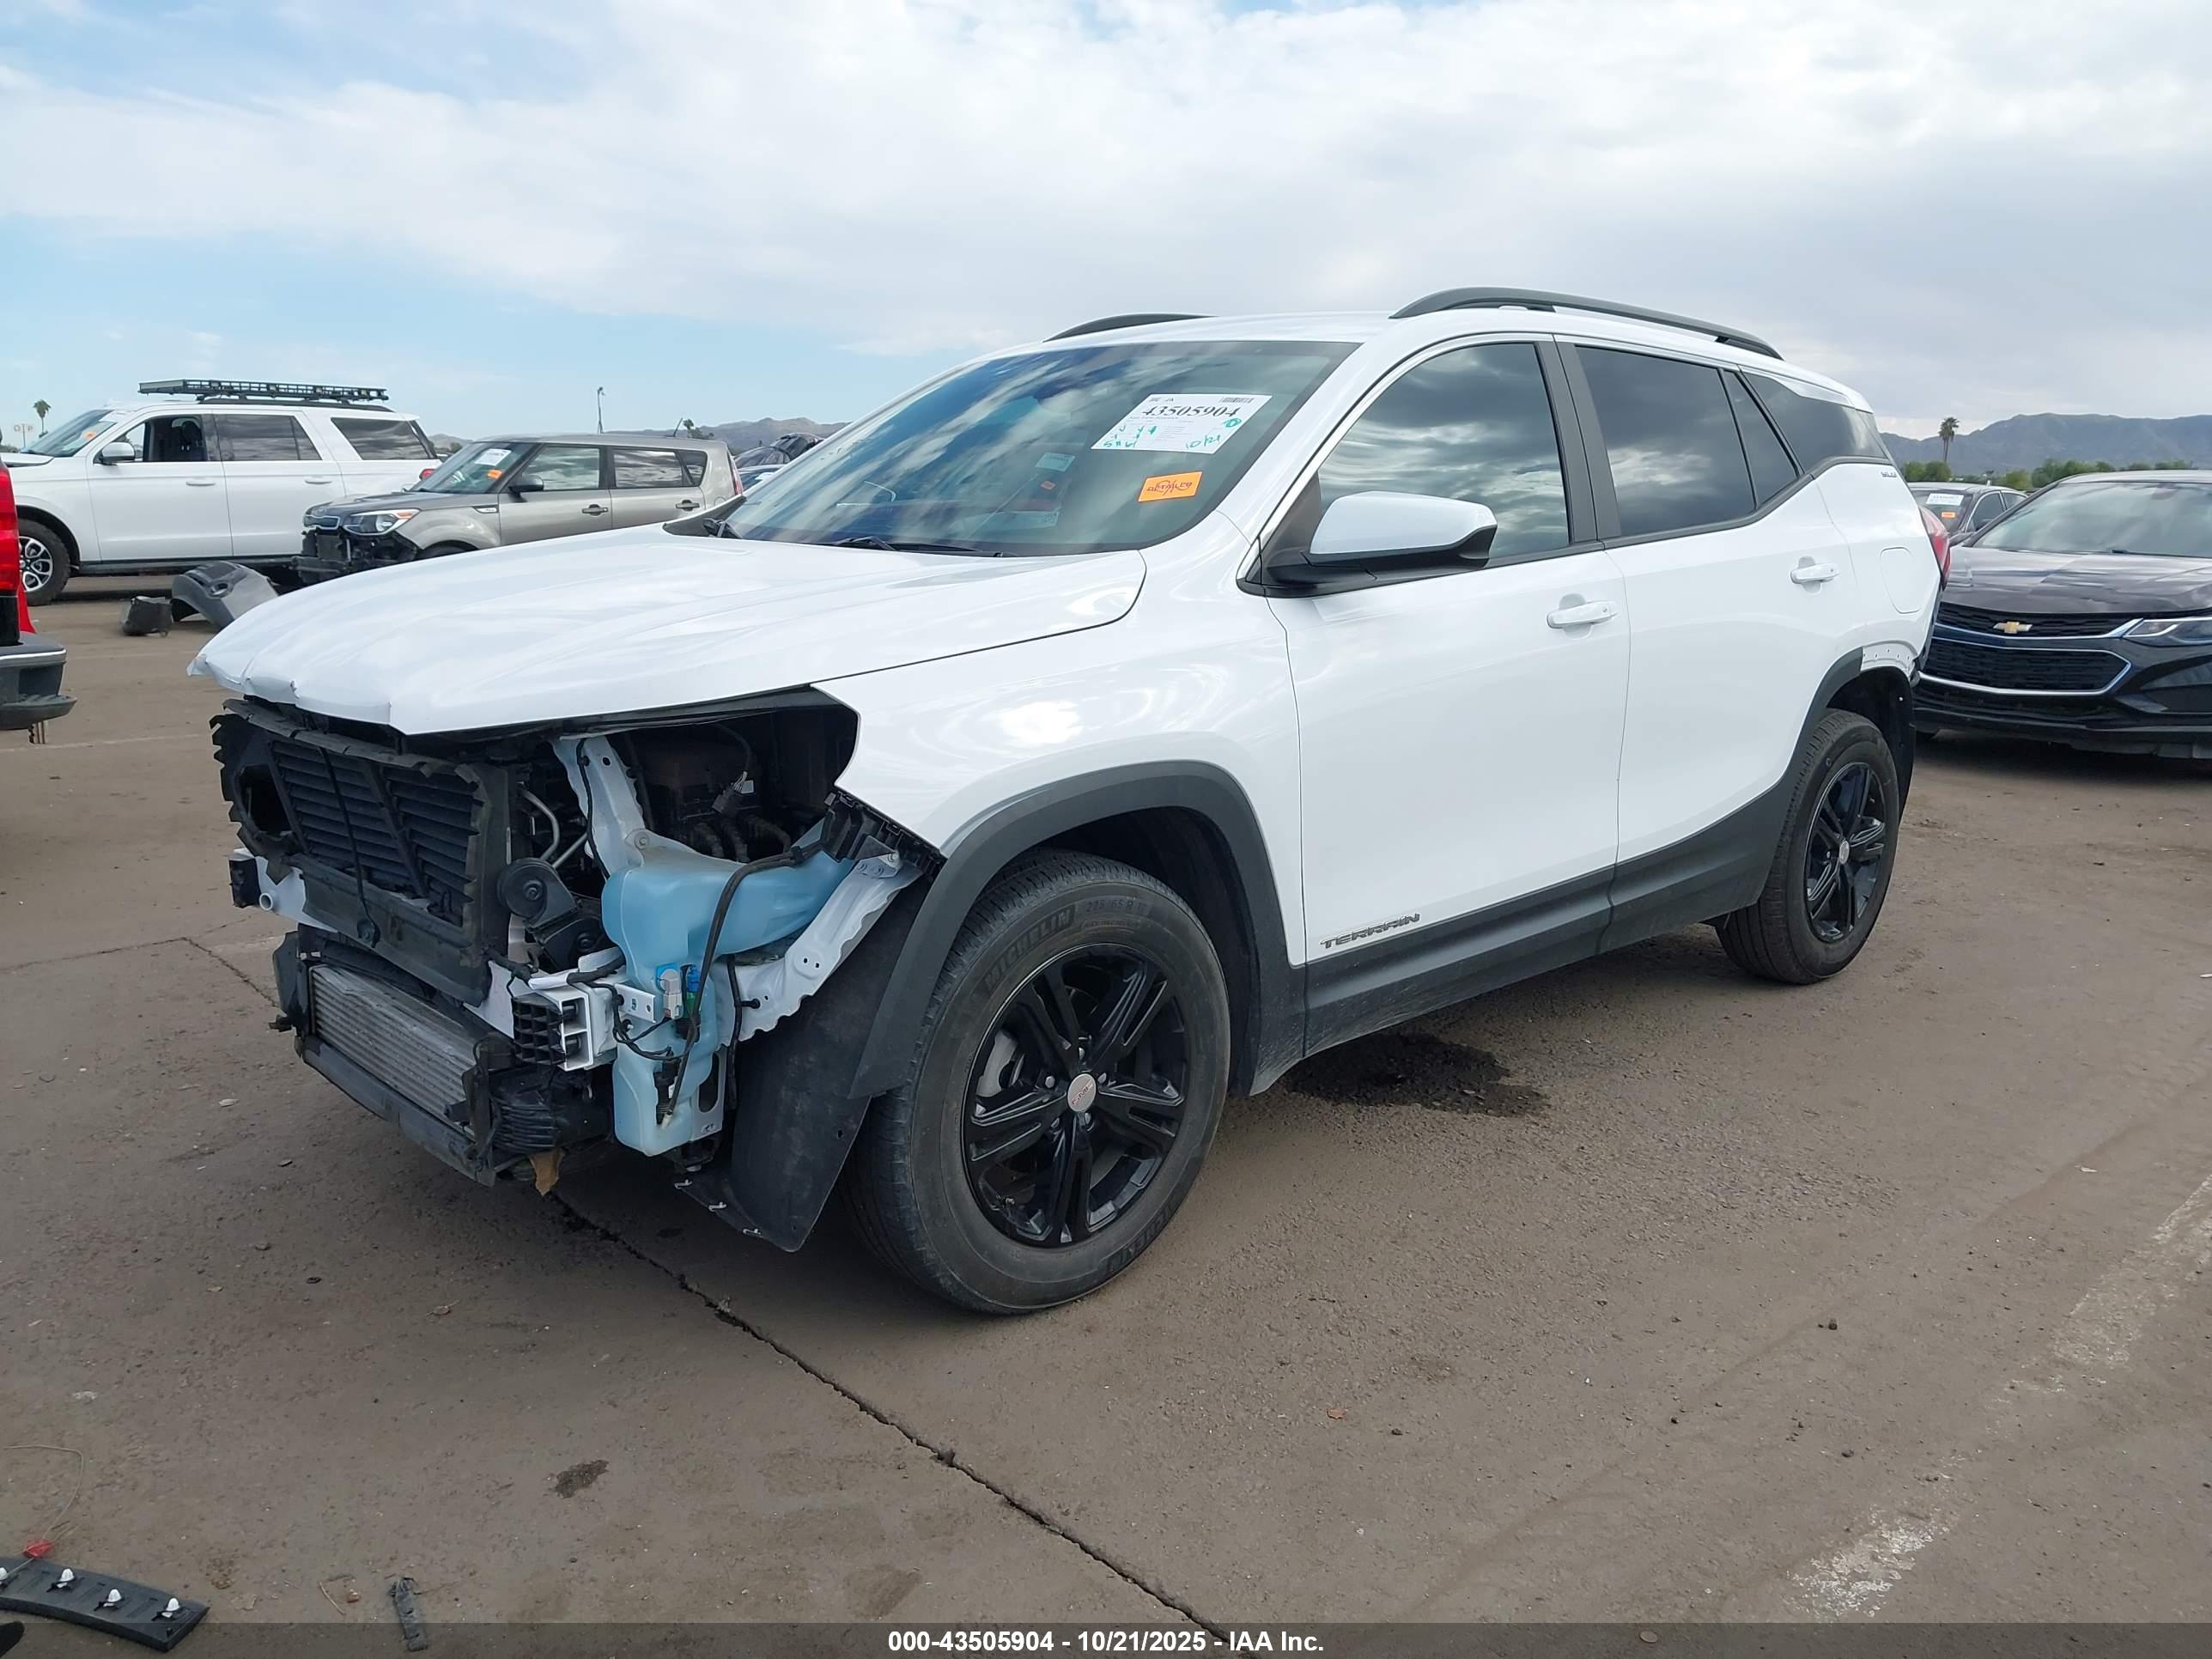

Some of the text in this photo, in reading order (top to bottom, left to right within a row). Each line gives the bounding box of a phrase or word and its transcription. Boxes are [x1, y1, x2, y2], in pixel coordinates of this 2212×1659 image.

[1142, 405, 1241, 417] 43505904
[984, 908, 1072, 990] MICHELIN
[1320, 913, 1420, 949] TERRAIN
